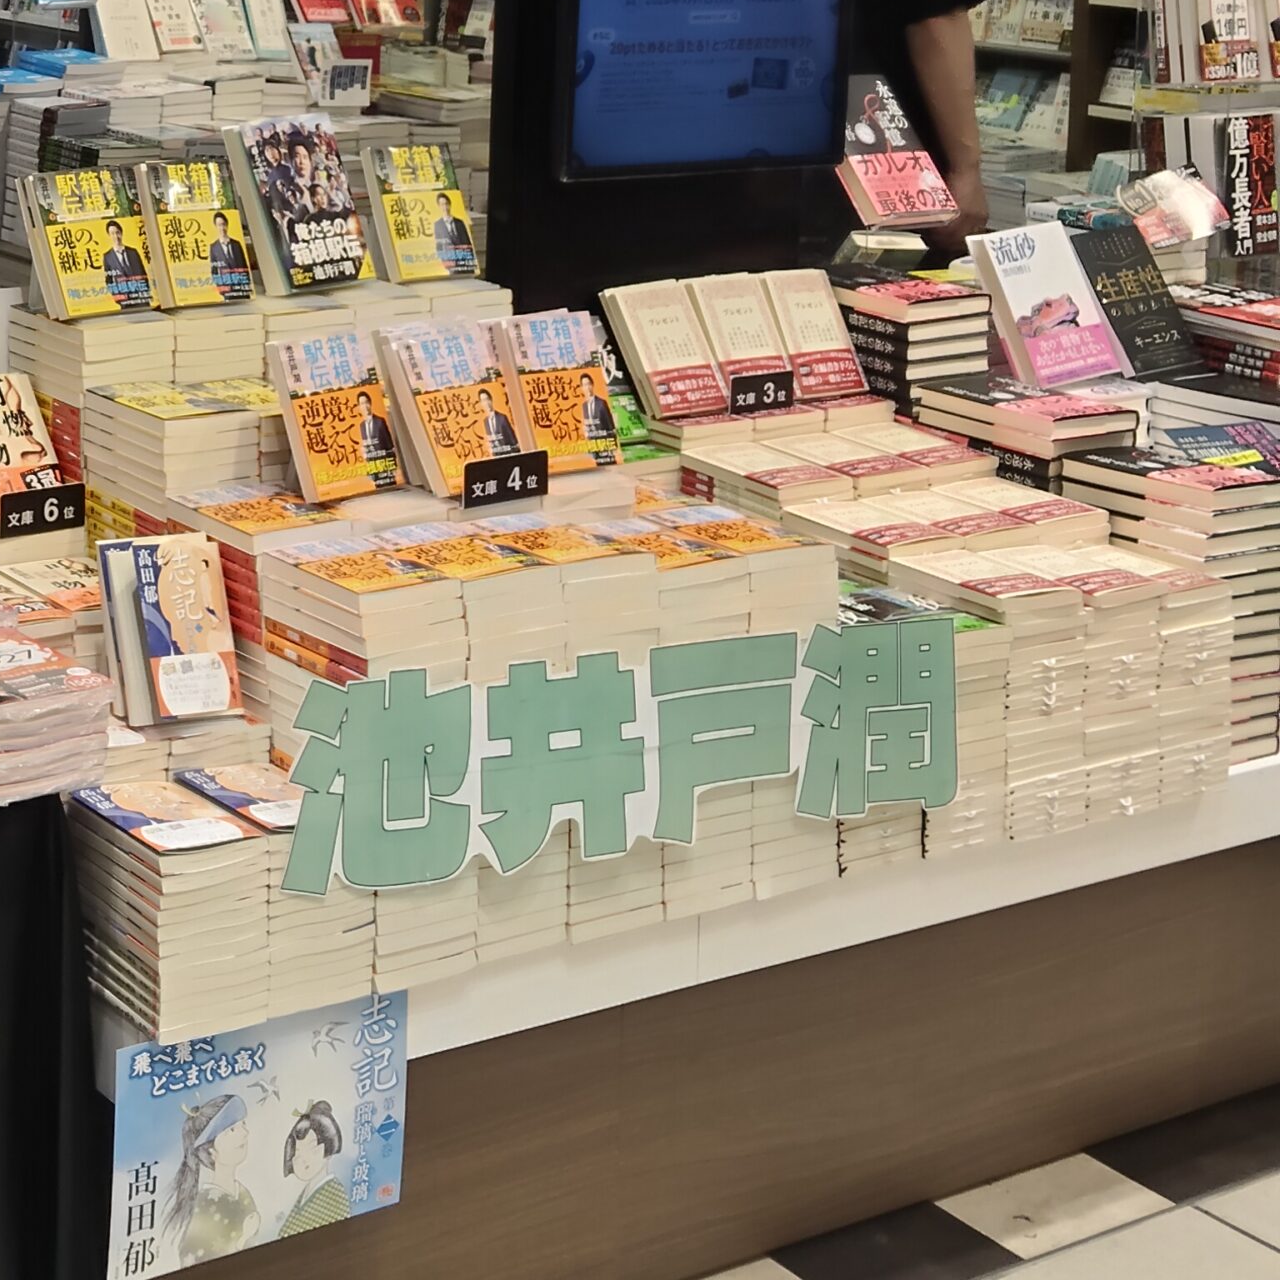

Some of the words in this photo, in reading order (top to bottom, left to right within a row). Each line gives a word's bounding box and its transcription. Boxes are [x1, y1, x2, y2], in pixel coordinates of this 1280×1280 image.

[294, 219, 347, 241] 俺たちの
[291, 237, 363, 265] 箱根駅伝
[990, 232, 1035, 265] 流砂
[313, 261, 355, 280] 池井戸潤
[1097, 265, 1168, 303] 生産性
[1134, 330, 1181, 346] キーエンス
[736, 392, 755, 405] 文庫
[763, 382, 775, 404] 3
[777, 390, 786, 402] 位
[532, 403, 581, 428] 越えて
[307, 424, 359, 454] 越えて
[434, 420, 484, 448] 越えて
[472, 481, 498, 498] 文庫
[507, 466, 522, 491] 4
[526, 475, 538, 488] 位
[8, 510, 33, 528] 文庫
[44, 498, 59, 521] 6
[63, 505, 75, 519] 位
[168, 548, 204, 621] 志記
[280, 618, 960, 898] 池井戸潤
[130, 1036, 215, 1077] 飛べ飛べ
[351, 994, 399, 1099] 志記
[151, 1043, 266, 1098] どこまでも高く
